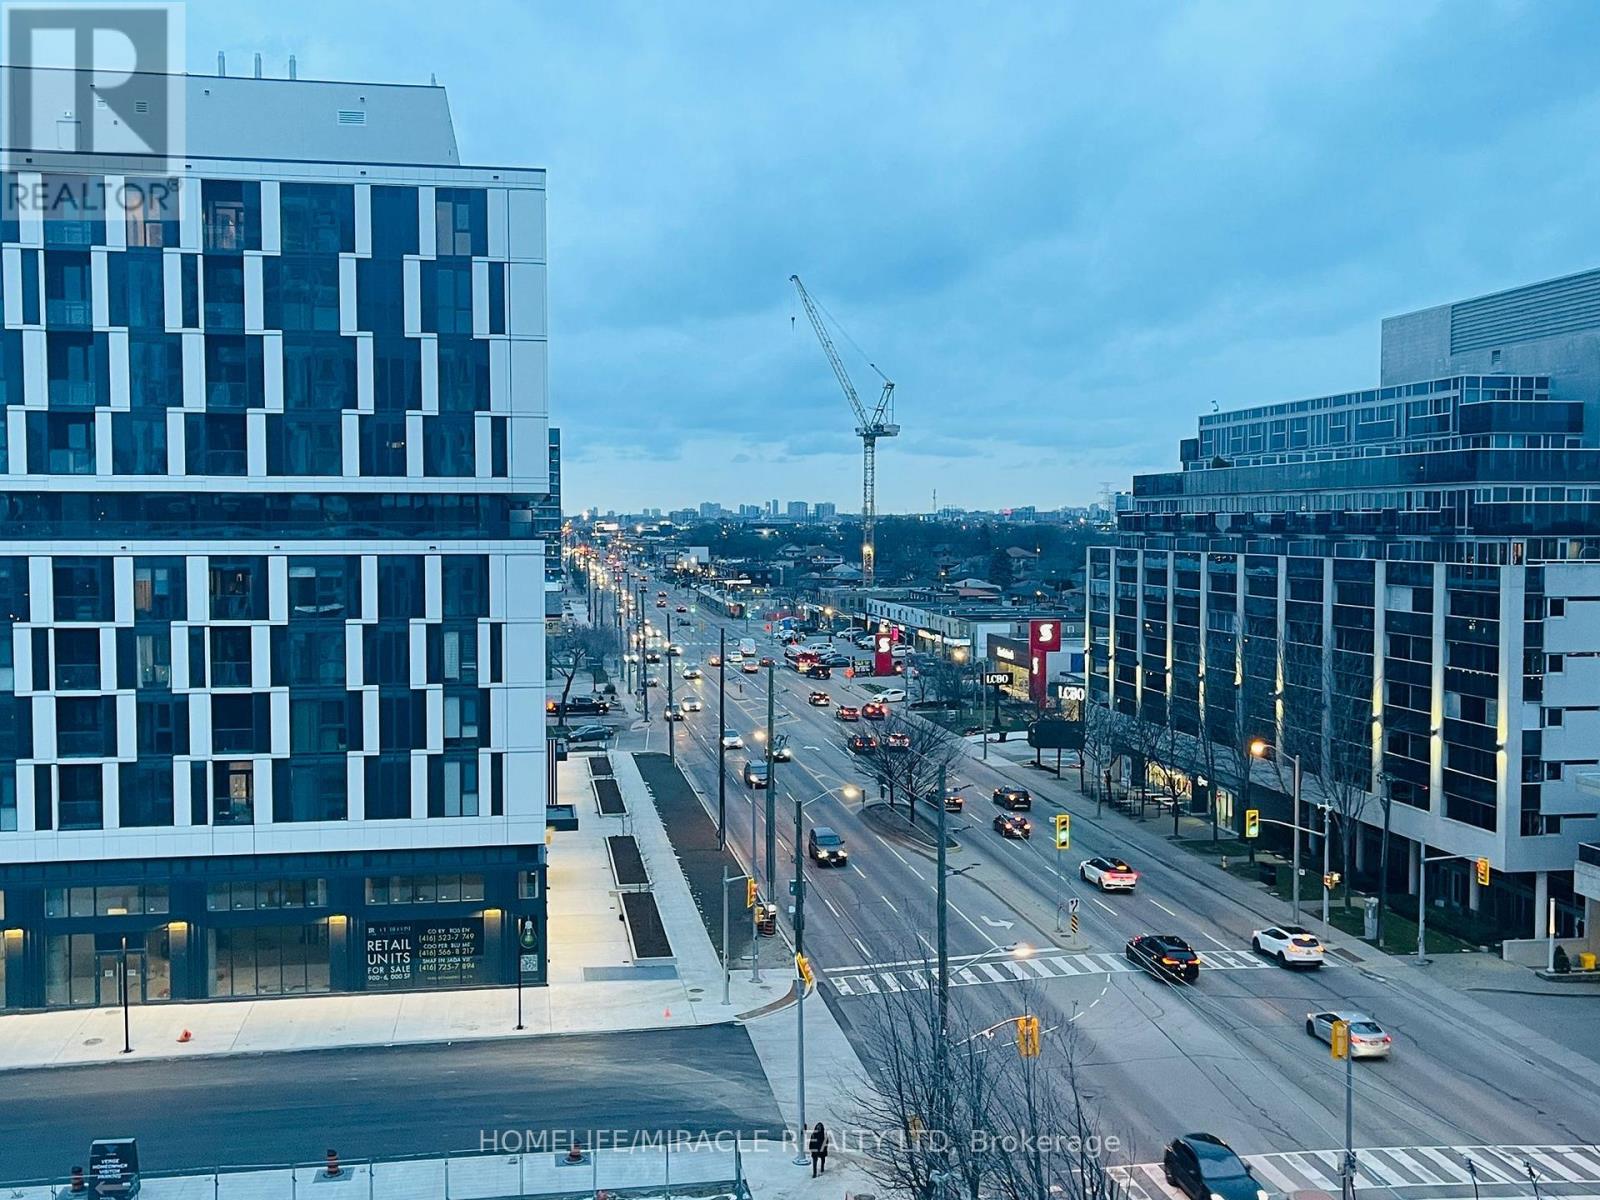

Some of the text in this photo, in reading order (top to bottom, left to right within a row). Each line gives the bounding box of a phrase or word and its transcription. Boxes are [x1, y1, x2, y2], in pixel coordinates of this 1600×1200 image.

[986, 674, 1009, 684] LCBO
[1058, 685, 1085, 701] LCBO
[419, 934, 436, 943] (416)
[367, 939, 411, 951] RETAIL
[367, 952, 411, 965] UNITS
[419, 949, 436, 958] (416)
[367, 965, 411, 975] FOR SALE
[419, 964, 436, 973] (416)
